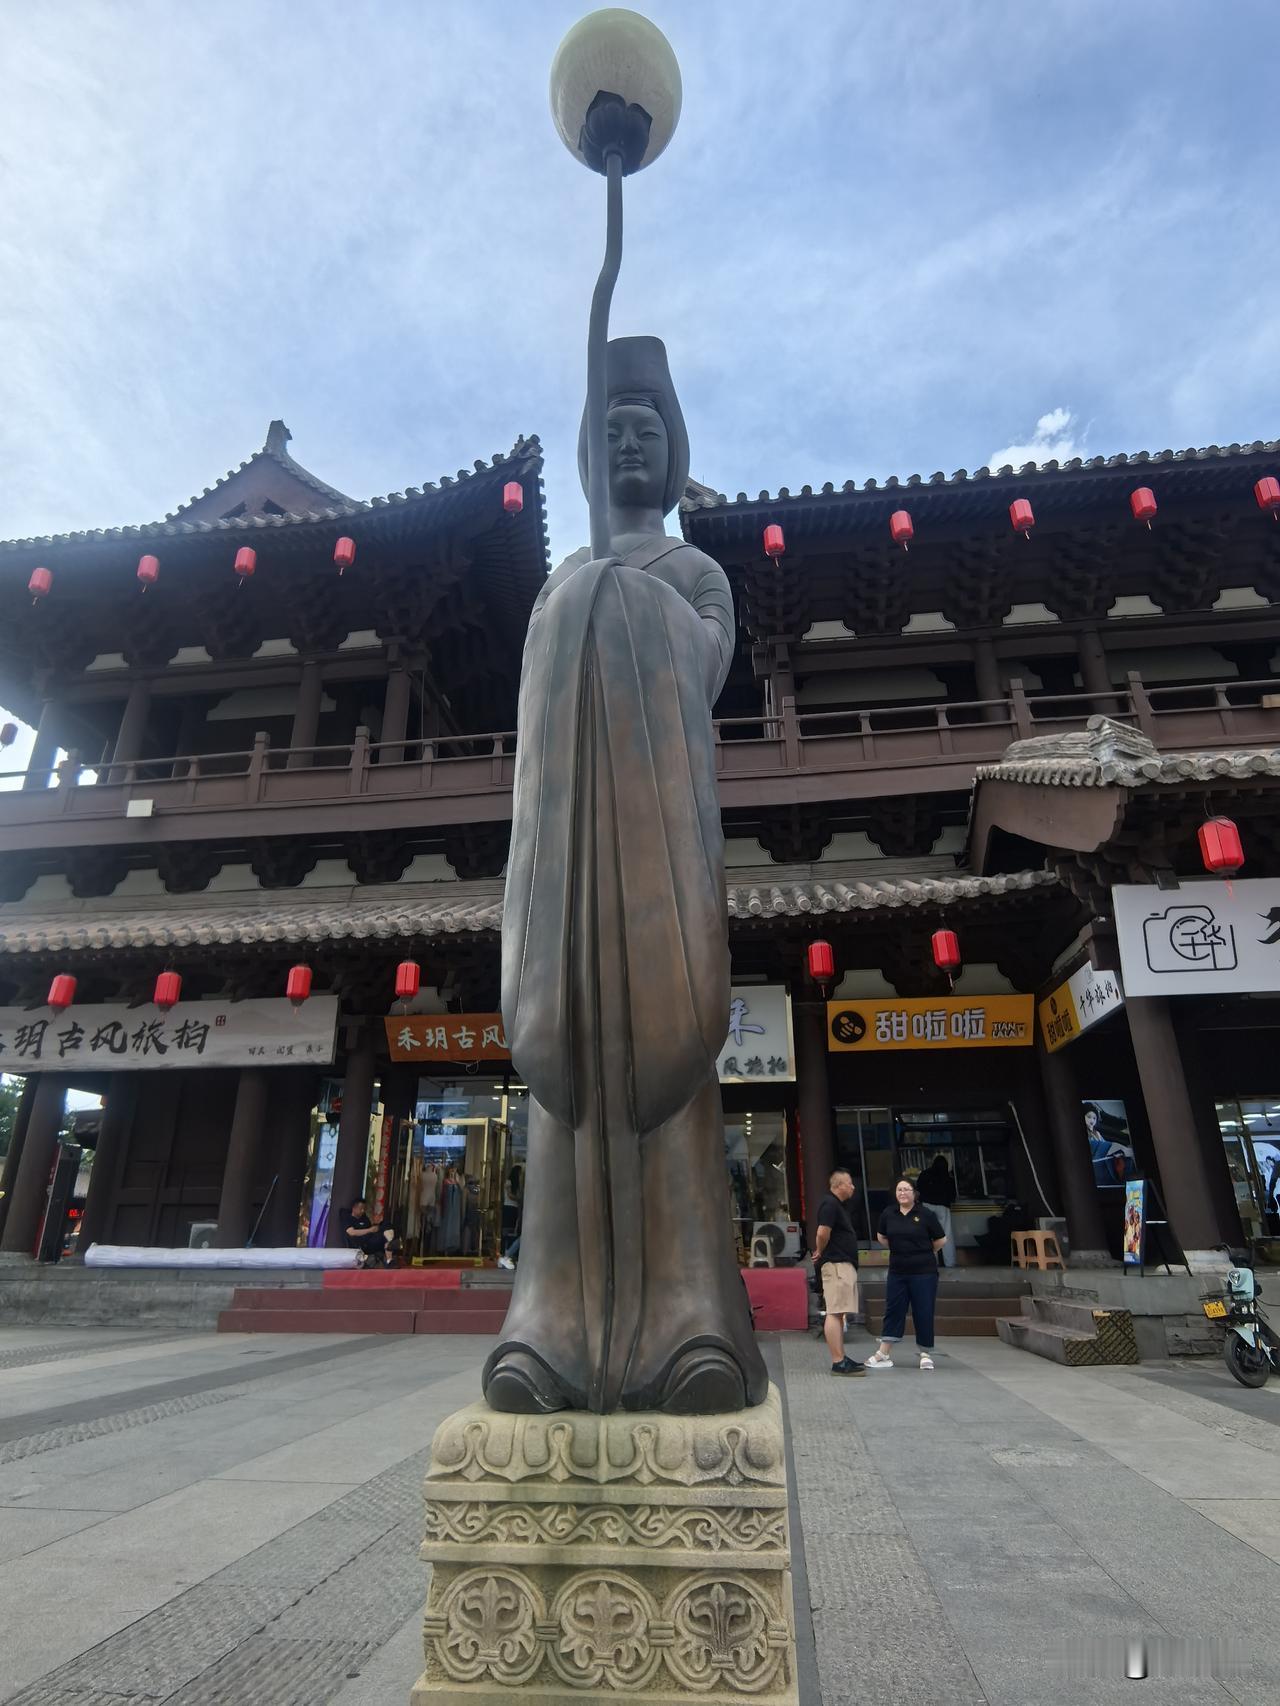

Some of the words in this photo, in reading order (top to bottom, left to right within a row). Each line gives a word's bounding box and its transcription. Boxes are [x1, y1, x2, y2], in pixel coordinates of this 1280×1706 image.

[0, 1018, 211, 1060] 玥古风旅拍
[397, 1024, 510, 1051] 禾玥古风
[875, 1008, 986, 1042] 甜啦啦
[1046, 1008, 1074, 1045] 甜啦啦
